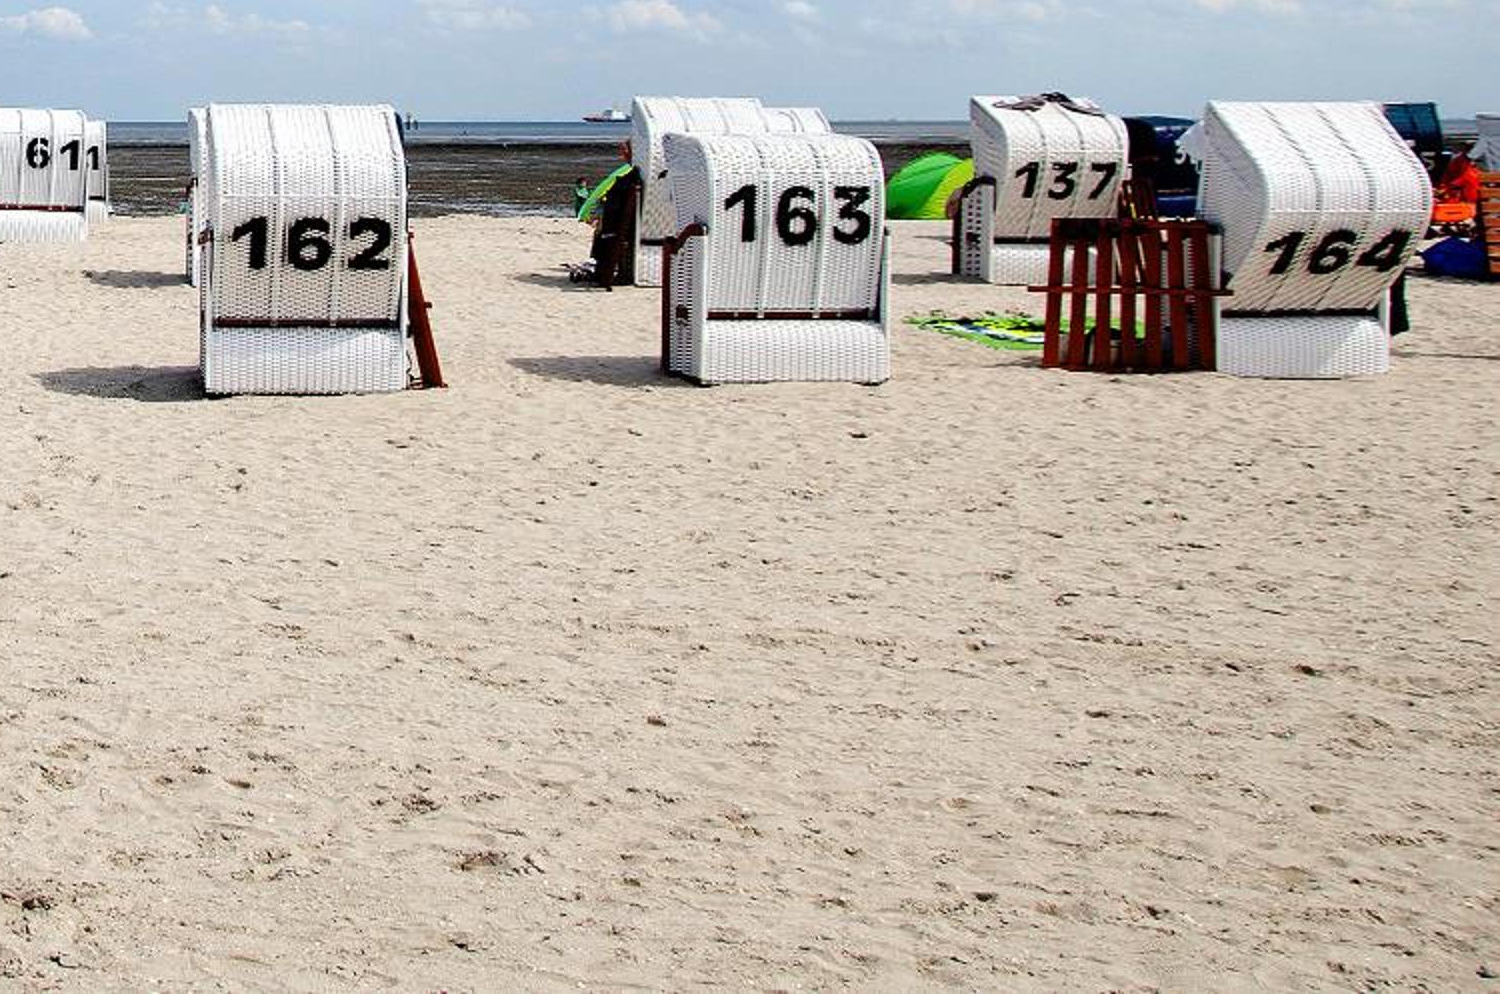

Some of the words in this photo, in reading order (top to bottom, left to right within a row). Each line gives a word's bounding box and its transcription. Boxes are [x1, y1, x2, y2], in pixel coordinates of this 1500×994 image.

[26, 137, 80, 171] 61
[1014, 161, 1118, 201] 137
[723, 183, 872, 248] 163
[231, 215, 393, 273] 162
[1264, 228, 1412, 275] 164
